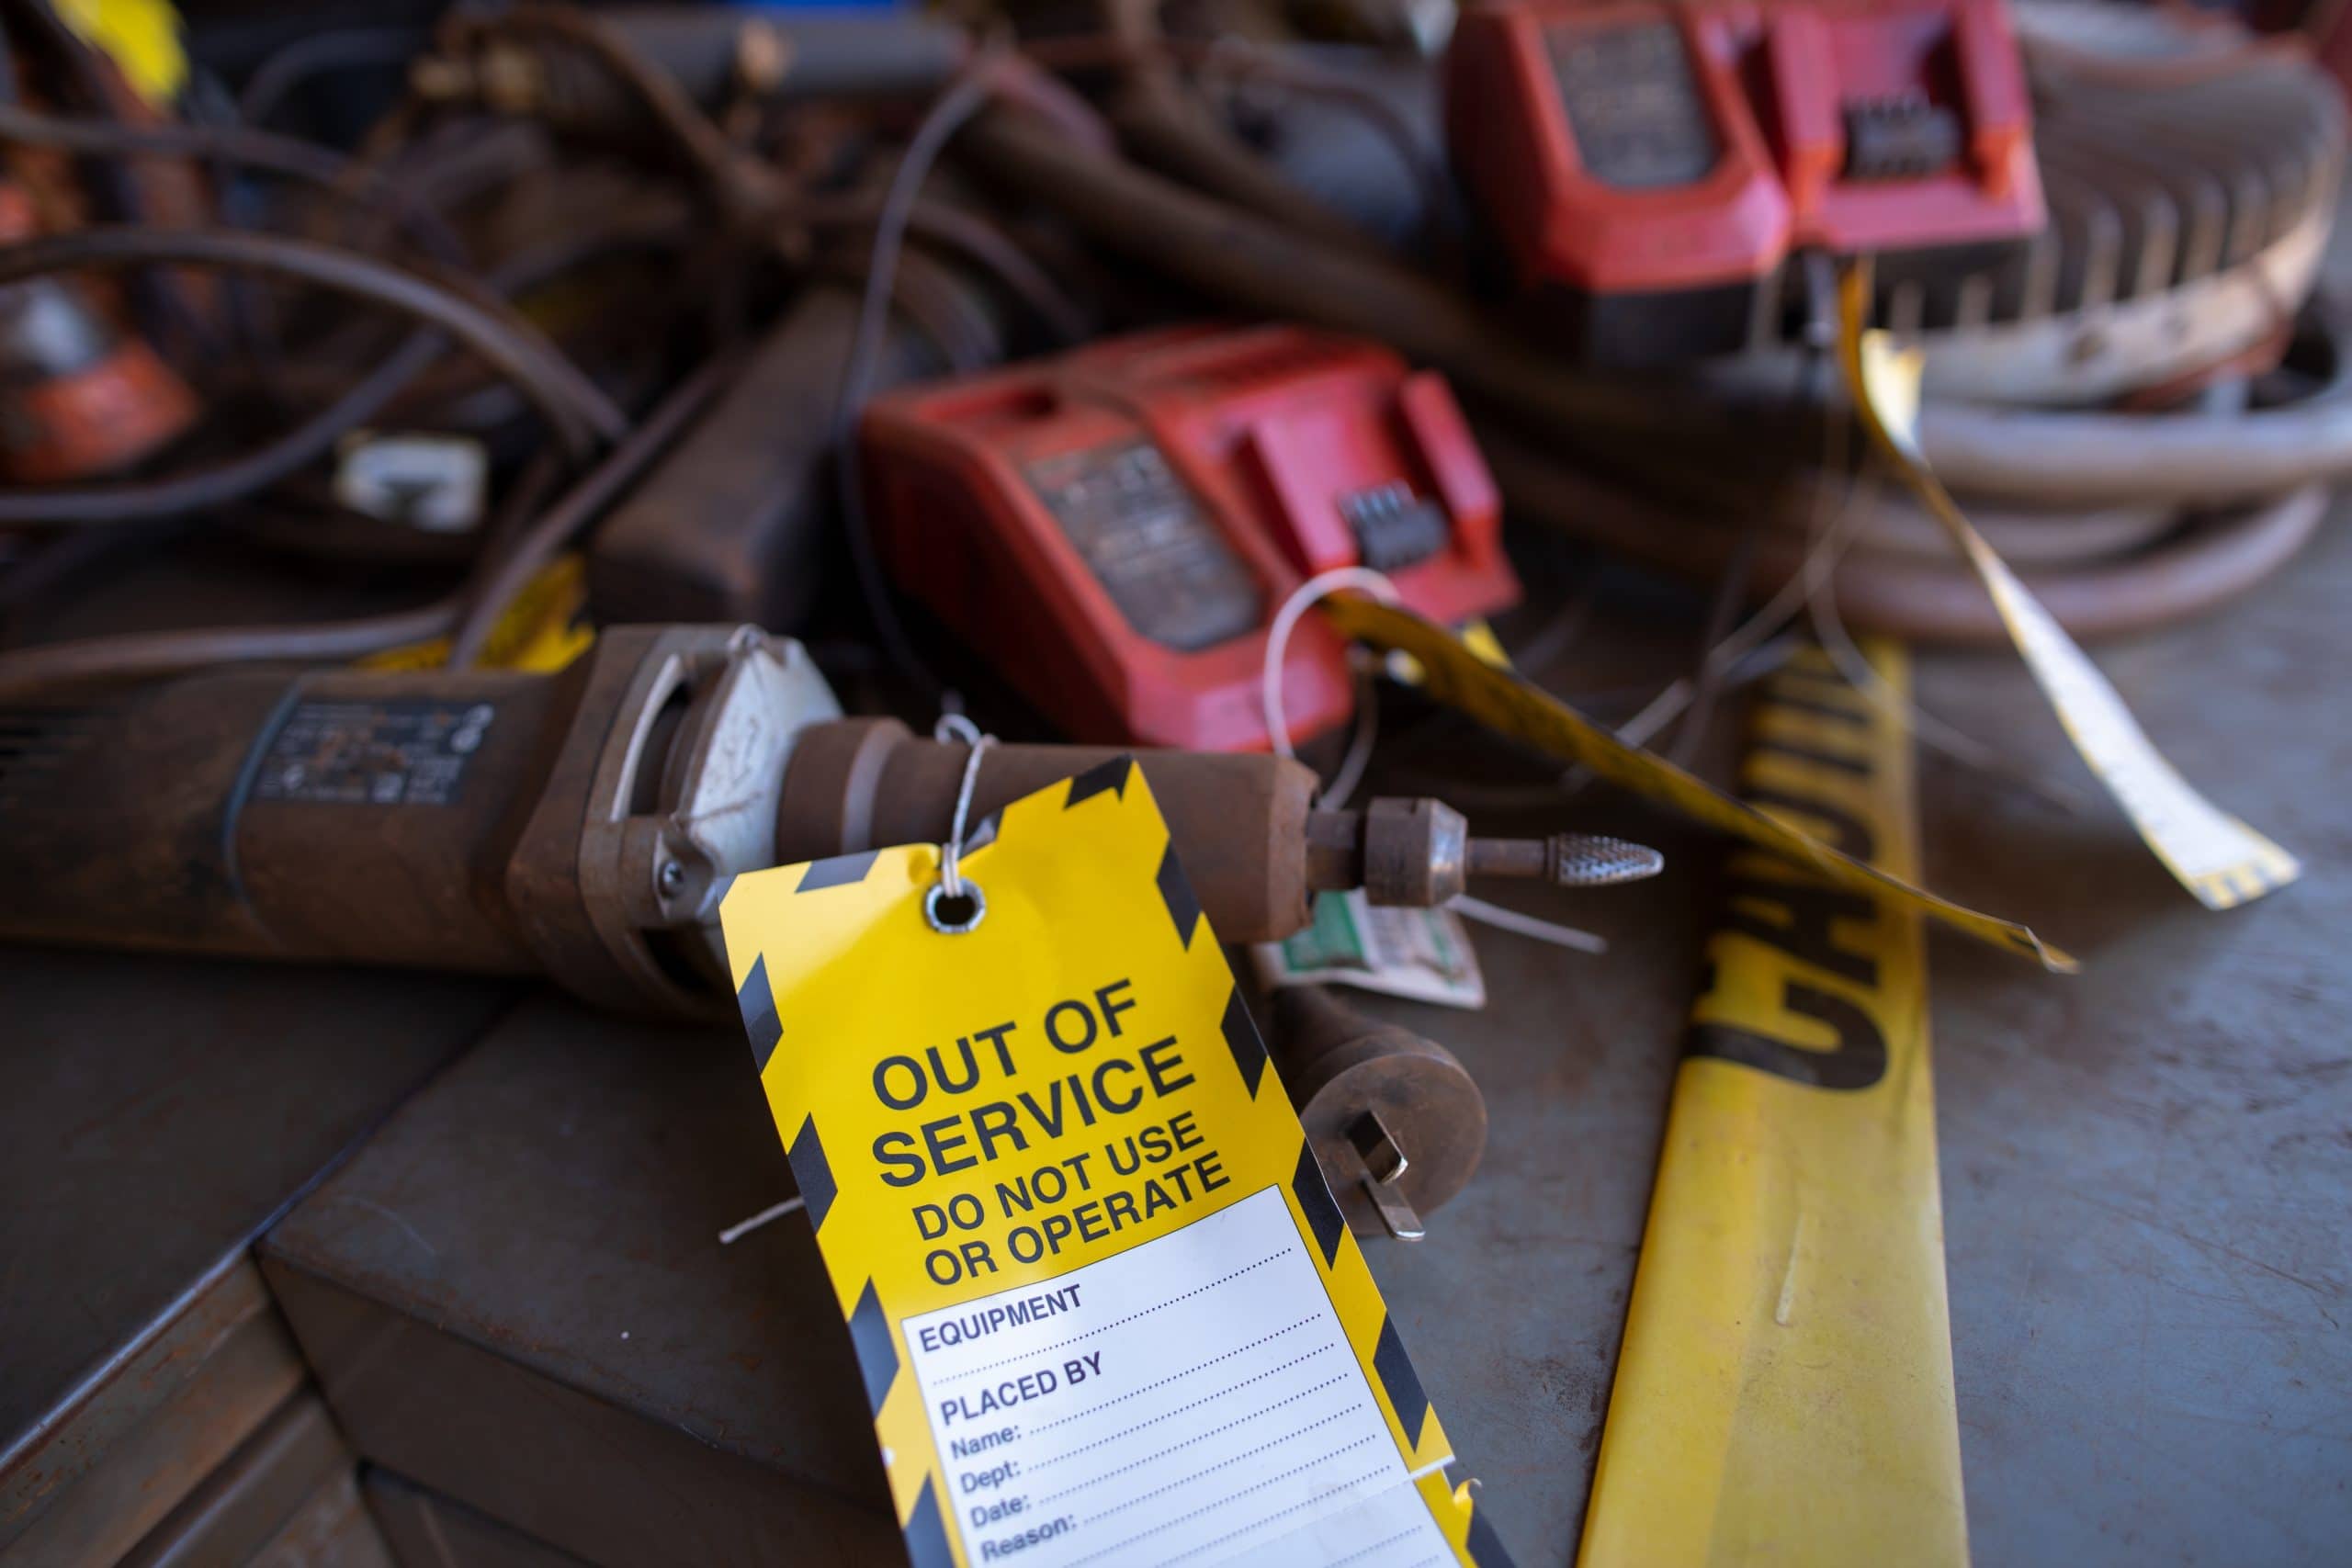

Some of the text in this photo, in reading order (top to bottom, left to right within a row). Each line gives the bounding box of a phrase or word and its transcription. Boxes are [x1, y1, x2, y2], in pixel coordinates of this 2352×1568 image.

[872, 977, 1137, 1111] OUT OF
[871, 1034, 1196, 1187] SERVICE
[911, 1110, 1206, 1241] DO NOT USE
[924, 1150, 1231, 1286] OR OPERATE
[919, 1283, 1081, 1352] EQUIPMENT
[940, 1350, 1102, 1426] PLACED BY
[950, 1425, 1022, 1459] Name:
[960, 1461, 1022, 1494] Dept:
[969, 1495, 1032, 1528] Date:
[980, 1513, 1078, 1562] Reason:
